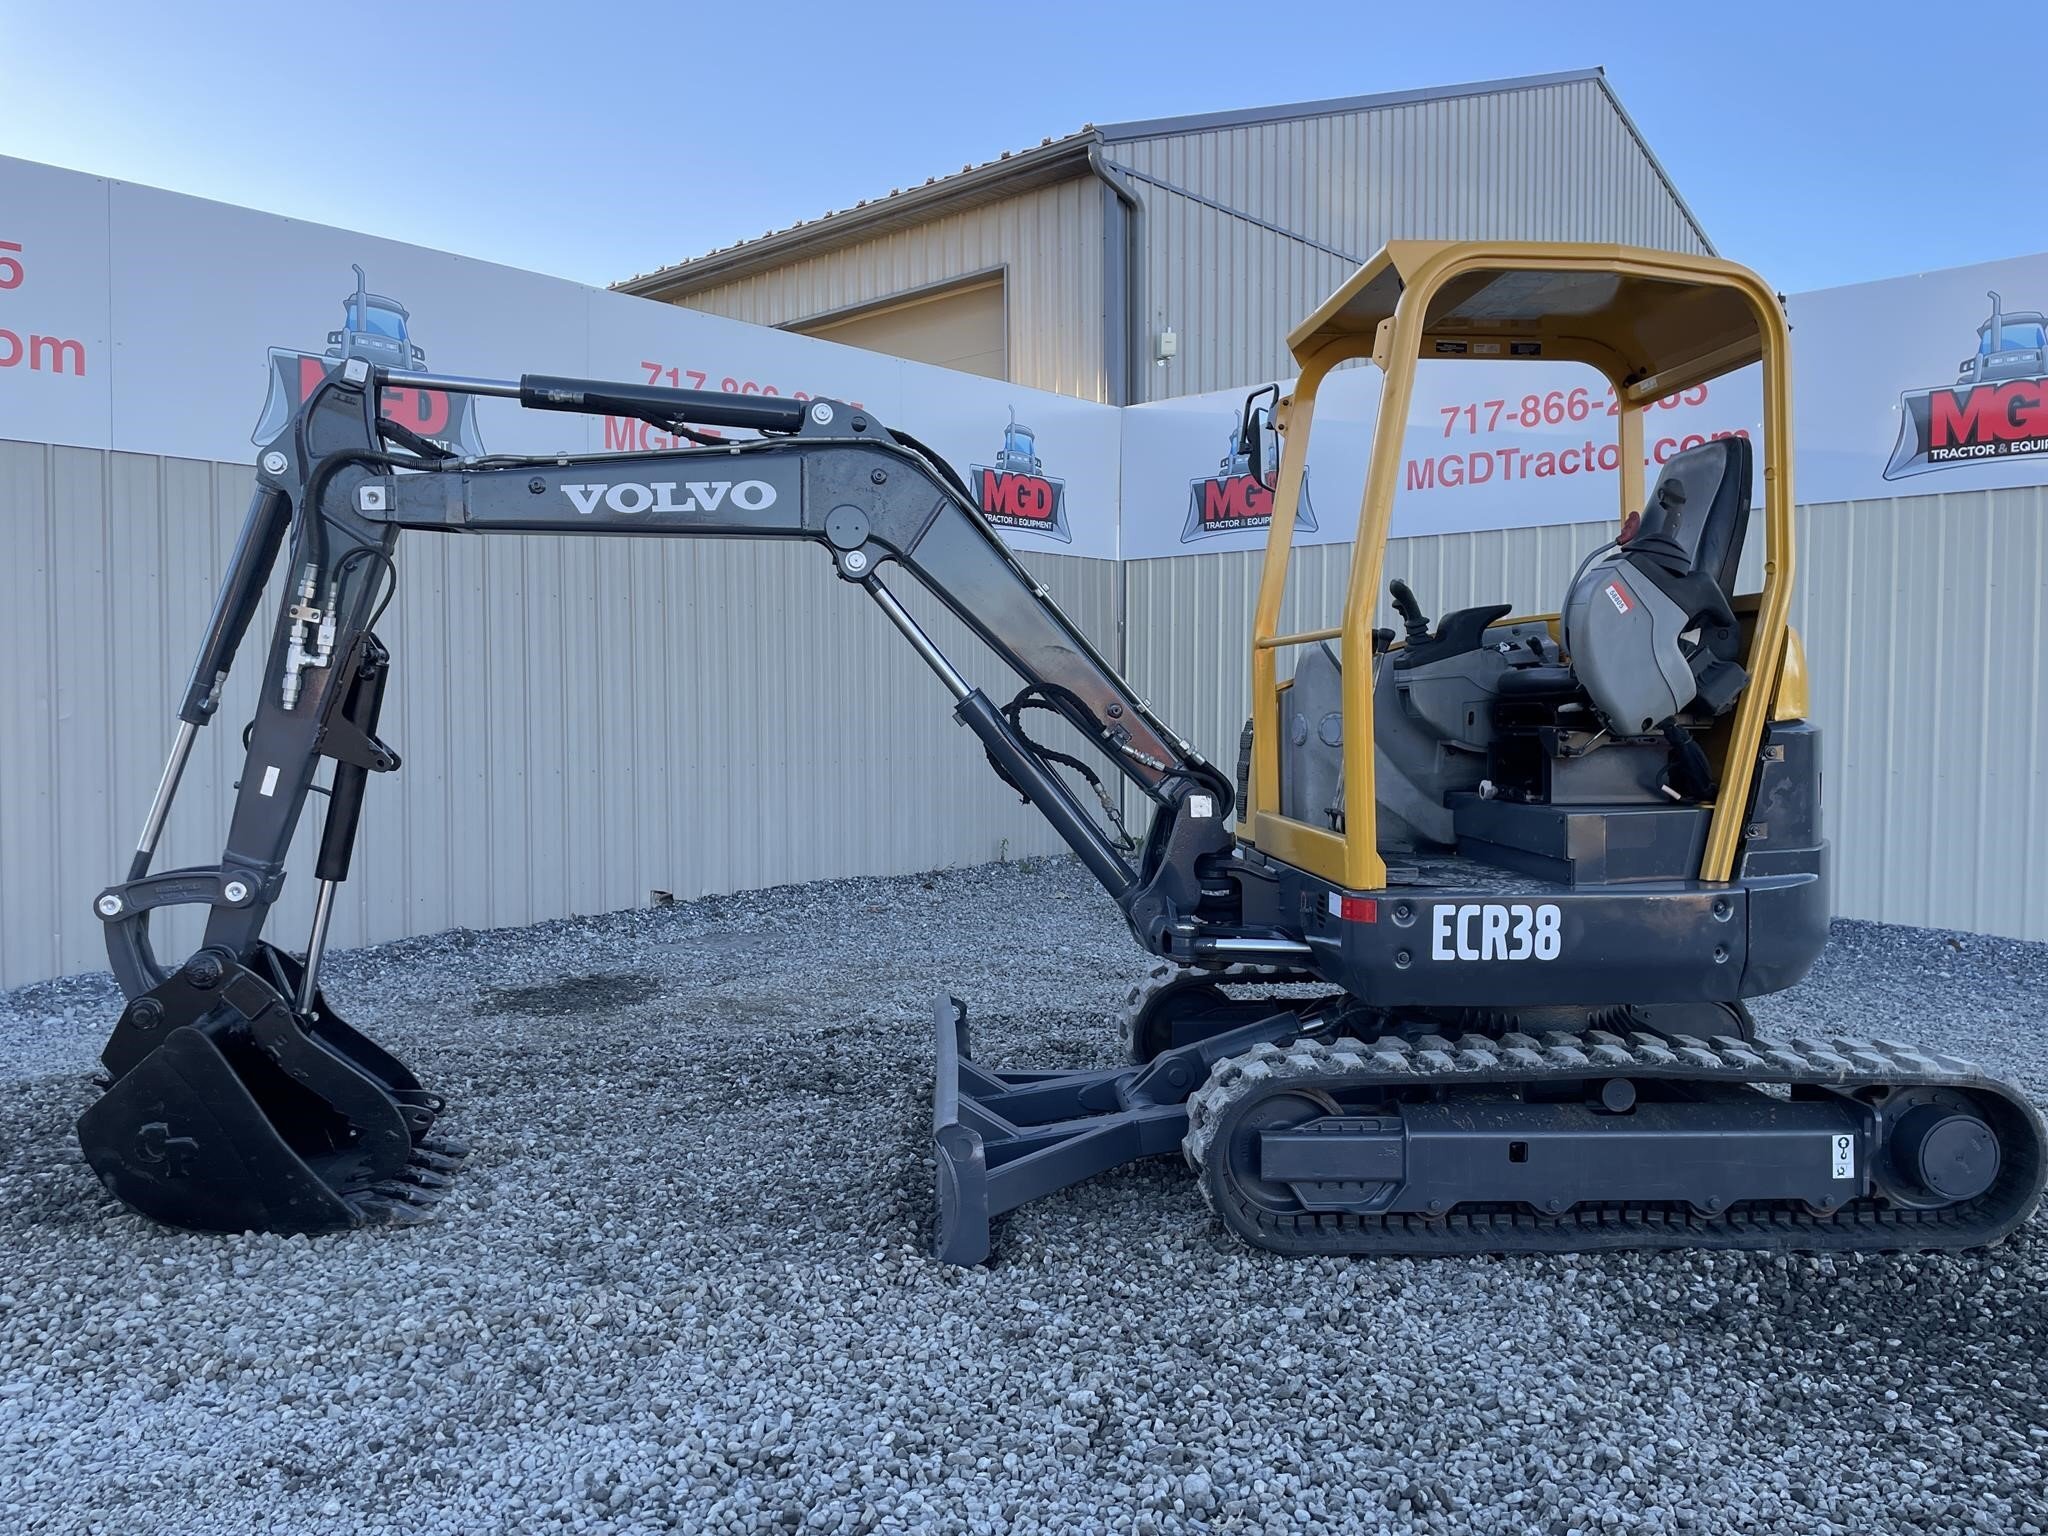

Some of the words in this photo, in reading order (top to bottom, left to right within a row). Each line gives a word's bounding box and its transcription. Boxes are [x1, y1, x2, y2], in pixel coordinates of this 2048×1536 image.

[1932, 379, 2048, 447] MG
[1931, 444, 1995, 460] TRACTOR
[1998, 443, 2008, 454] &
[560, 480, 777, 514] VOLVO
[984, 470, 1053, 519] MGD
[984, 513, 1013, 525] TRACTOR
[1019, 518, 1053, 529] EQUIPMENT
[1206, 519, 1240, 529] TRACTOR
[1247, 516, 1272, 526] EQUIP
[1432, 904, 1562, 961] ECR38
